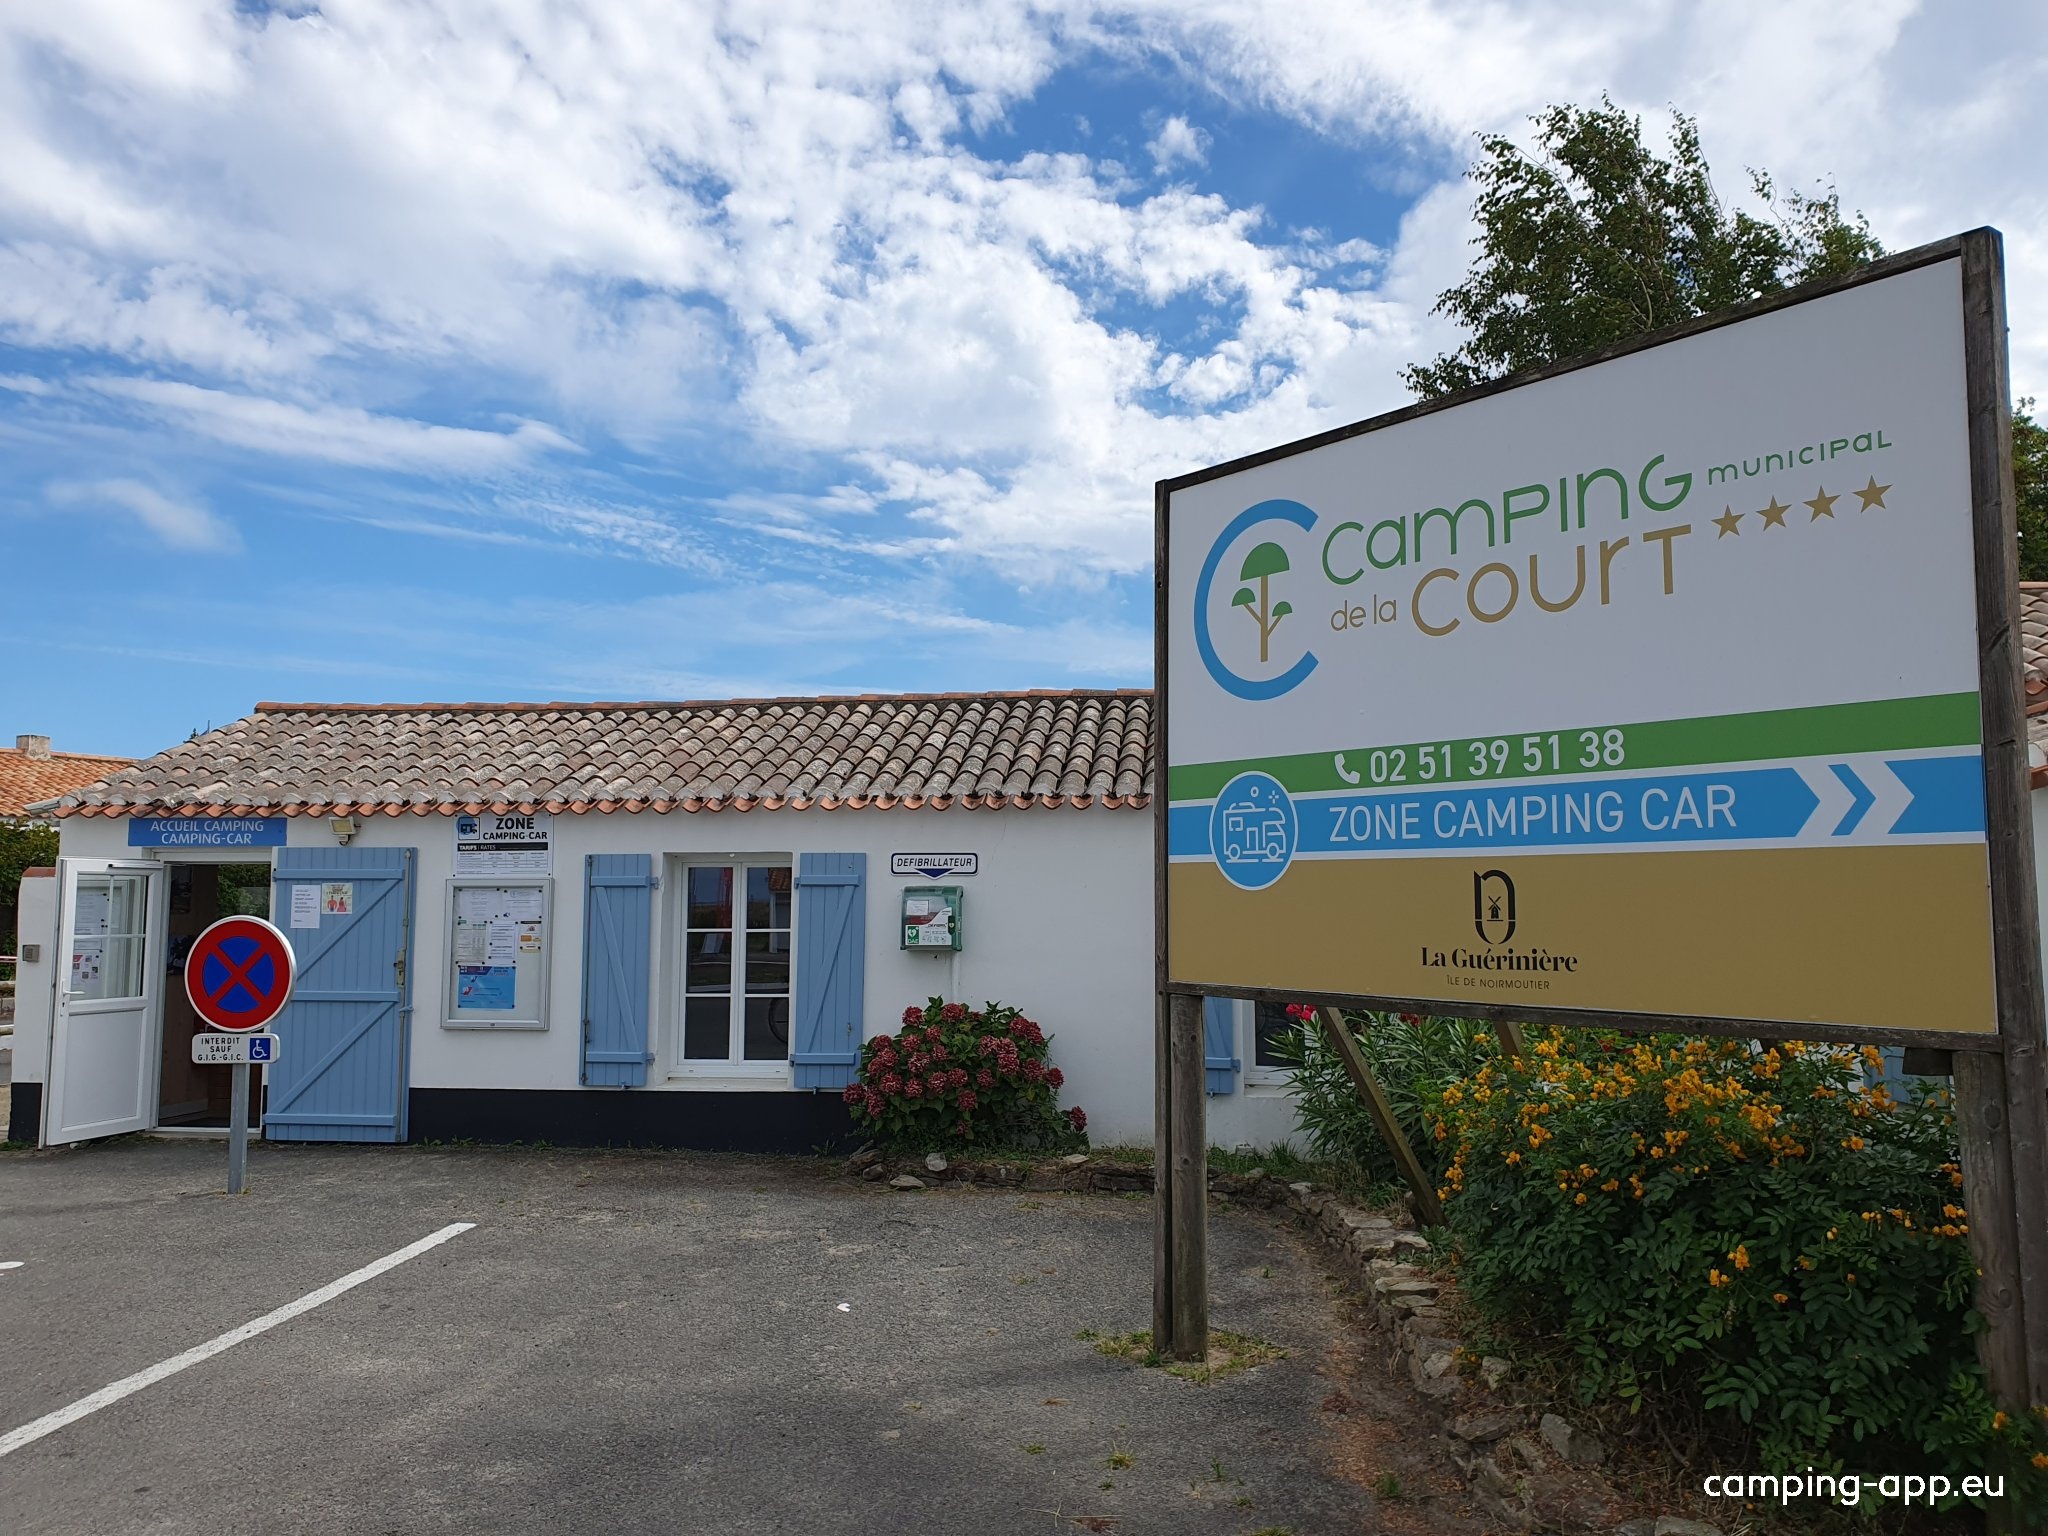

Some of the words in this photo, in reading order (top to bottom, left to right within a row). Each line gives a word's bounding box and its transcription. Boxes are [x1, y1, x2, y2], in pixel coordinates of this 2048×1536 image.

[1331, 599, 1367, 632] de
[1373, 594, 1397, 625] la
[1370, 748, 1406, 783] 02
[1418, 744, 1452, 779] 51
[1468, 739, 1510, 776] 39
[1523, 734, 1560, 773] 51
[1579, 728, 1626, 768] 38
[1329, 802, 1421, 842] ZONE
[1433, 790, 1624, 838] CAMPING
[1640, 784, 1737, 831] CAR
[150, 820, 199, 832] ACCUEIL
[204, 820, 264, 832] CAMPING
[495, 817, 535, 830] ZONE
[161, 833, 252, 845] CAMPING-CAR
[482, 831, 548, 840] CAMPING-CAR
[896, 857, 972, 867] DEFIBRILLATEUR
[1421, 947, 1446, 967] La
[1451, 948, 1578, 972] Guérinière
[1463, 977, 1476, 987] DE
[1479, 978, 1550, 990] NOIRMOUTIER
[201, 1037, 241, 1045] INTERDIT
[209, 1045, 232, 1053] SAUF
[197, 1053, 244, 1061] G.I.G.-G.I.C.
